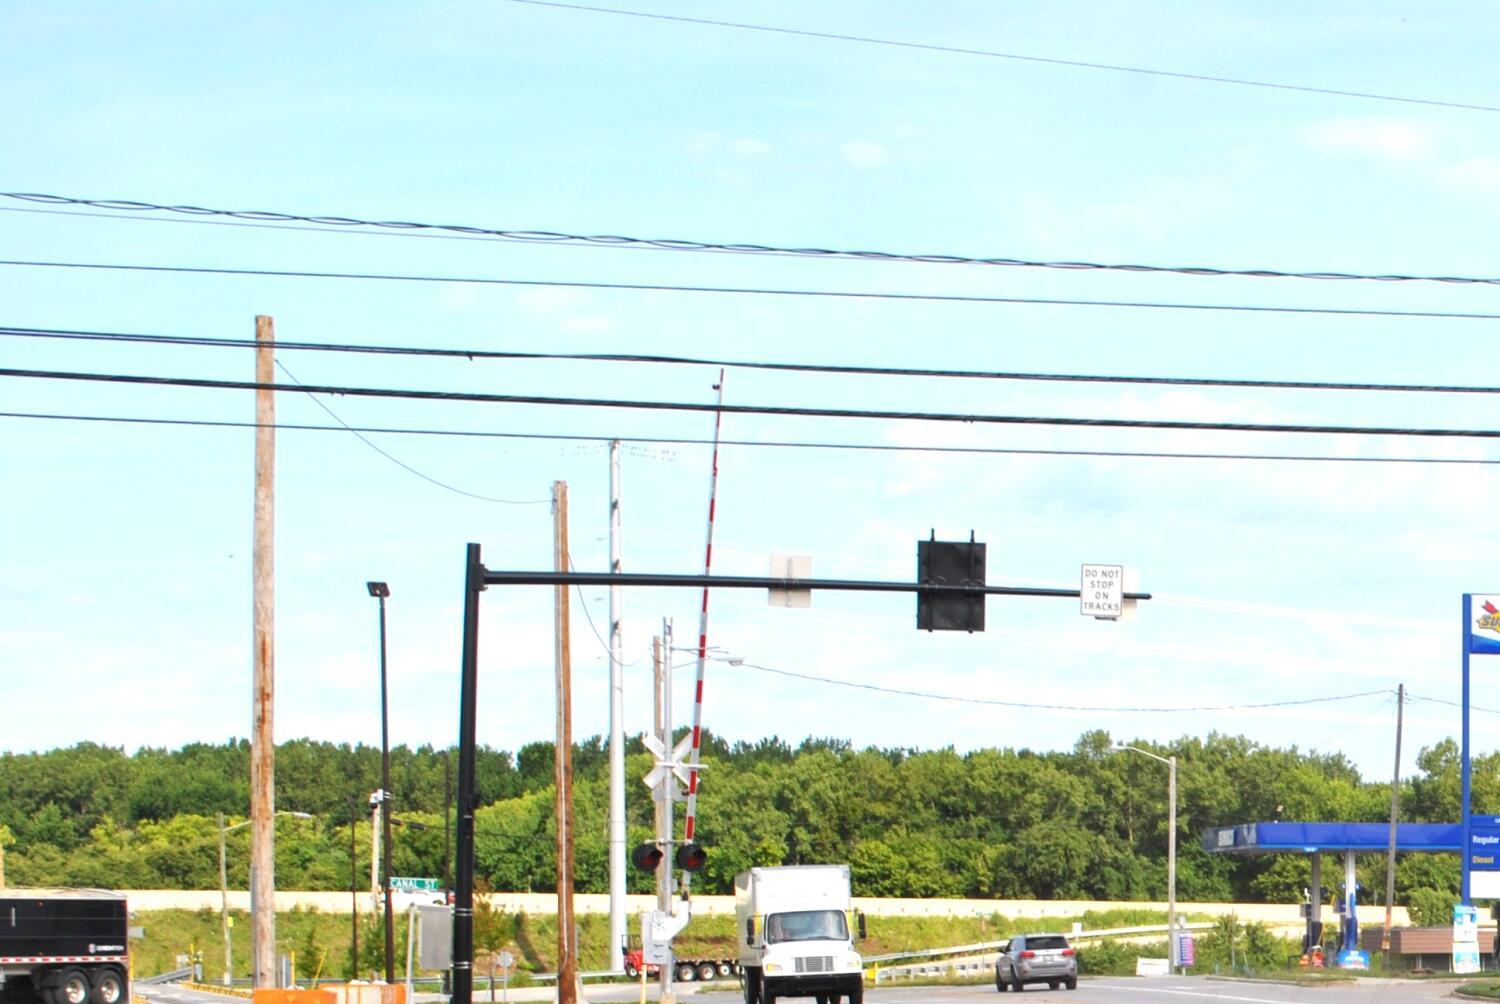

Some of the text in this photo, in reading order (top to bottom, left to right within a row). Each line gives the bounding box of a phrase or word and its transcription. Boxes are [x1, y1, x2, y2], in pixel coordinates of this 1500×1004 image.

[1085, 569, 1119, 578] DO NOT
[1090, 580, 1114, 589] STOP
[1095, 591, 1109, 600] ON
[1084, 602, 1120, 611] TRACKS
[1472, 835, 1500, 845] Regular
